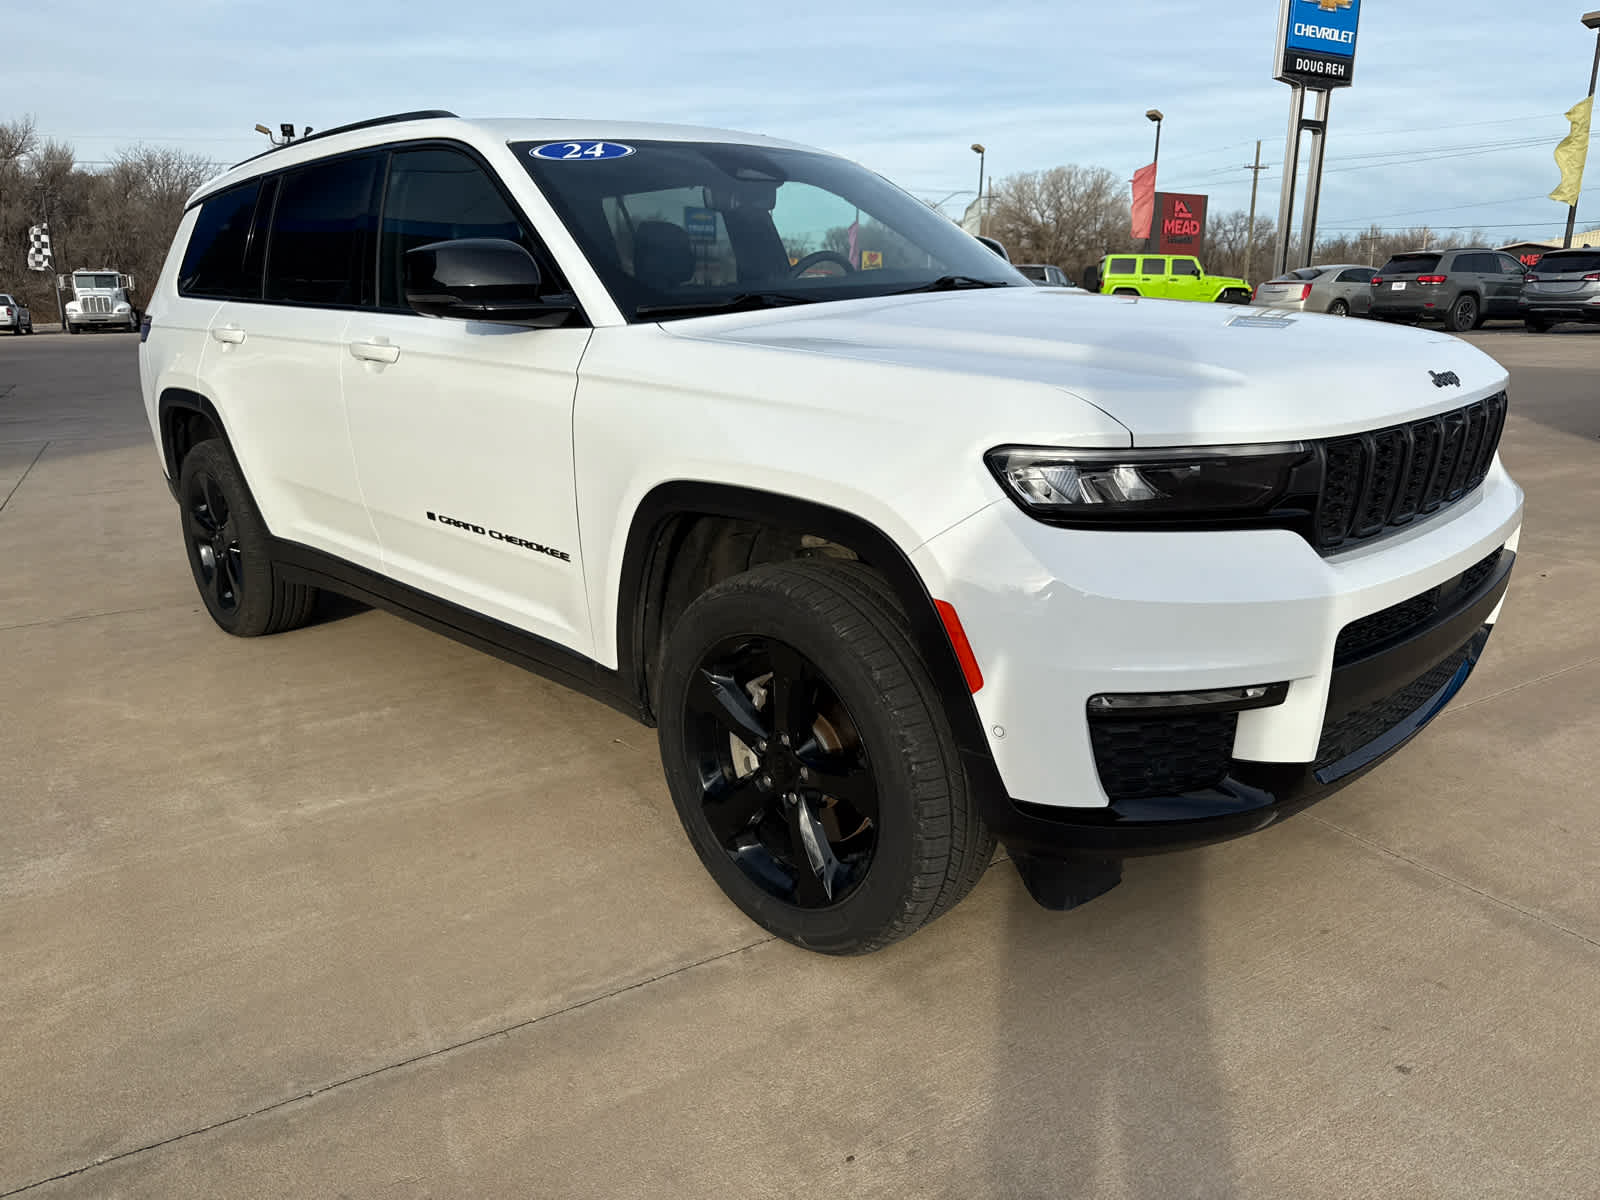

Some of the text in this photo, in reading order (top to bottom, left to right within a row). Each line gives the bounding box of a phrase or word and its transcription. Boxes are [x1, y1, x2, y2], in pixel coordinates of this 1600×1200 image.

[1294, 22, 1354, 44] CHEVROLET
[1295, 58, 1345, 77] DOUG REH
[562, 142, 605, 159] 24
[1163, 219, 1200, 236] MEAD
[1519, 253, 1542, 267] ME
[1428, 369, 1461, 388] Jeep
[438, 514, 571, 563] GRAND CHEROKEE
